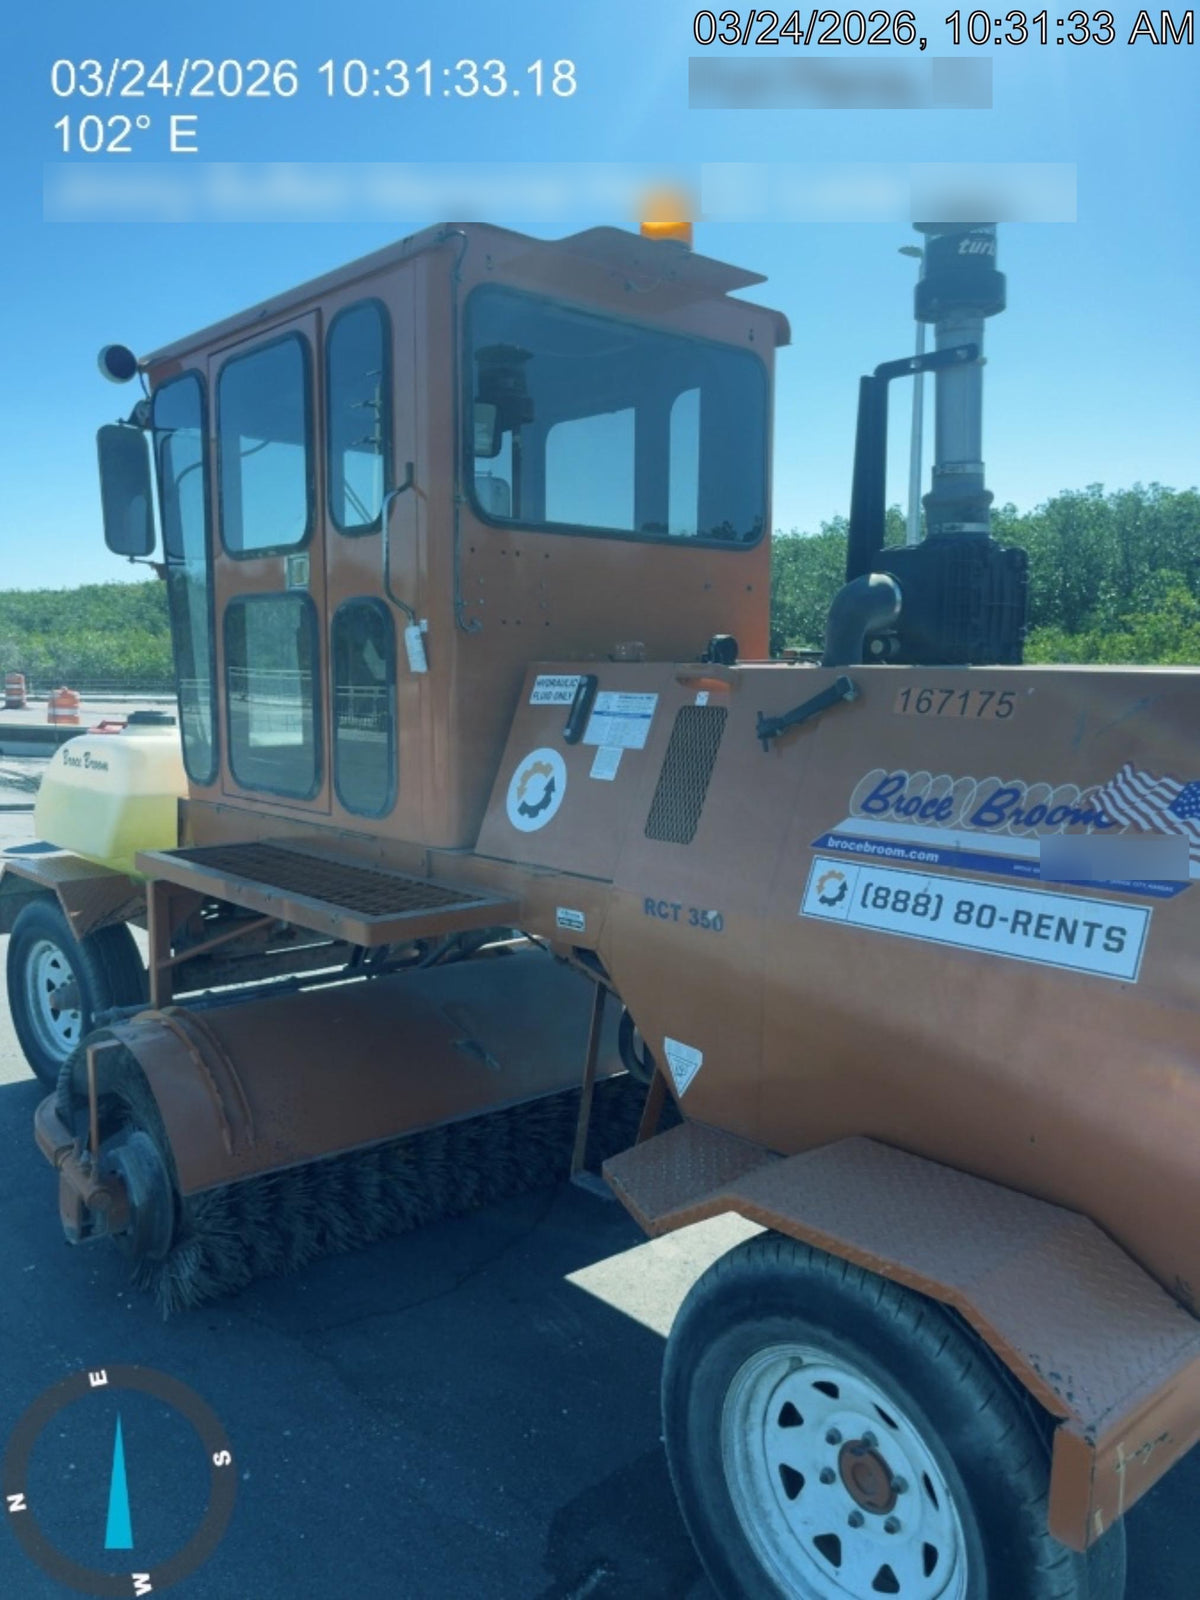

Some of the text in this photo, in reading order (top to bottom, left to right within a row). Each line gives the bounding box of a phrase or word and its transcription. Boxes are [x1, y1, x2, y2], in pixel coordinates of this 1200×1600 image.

[900, 687, 1017, 719] 167175
[860, 775, 1118, 829] Broce Broom
[827, 836, 940, 863] brocebroom.com
[643, 897, 725, 932] RCT 350
[860, 881, 1128, 955] (888) 80-RENTS
